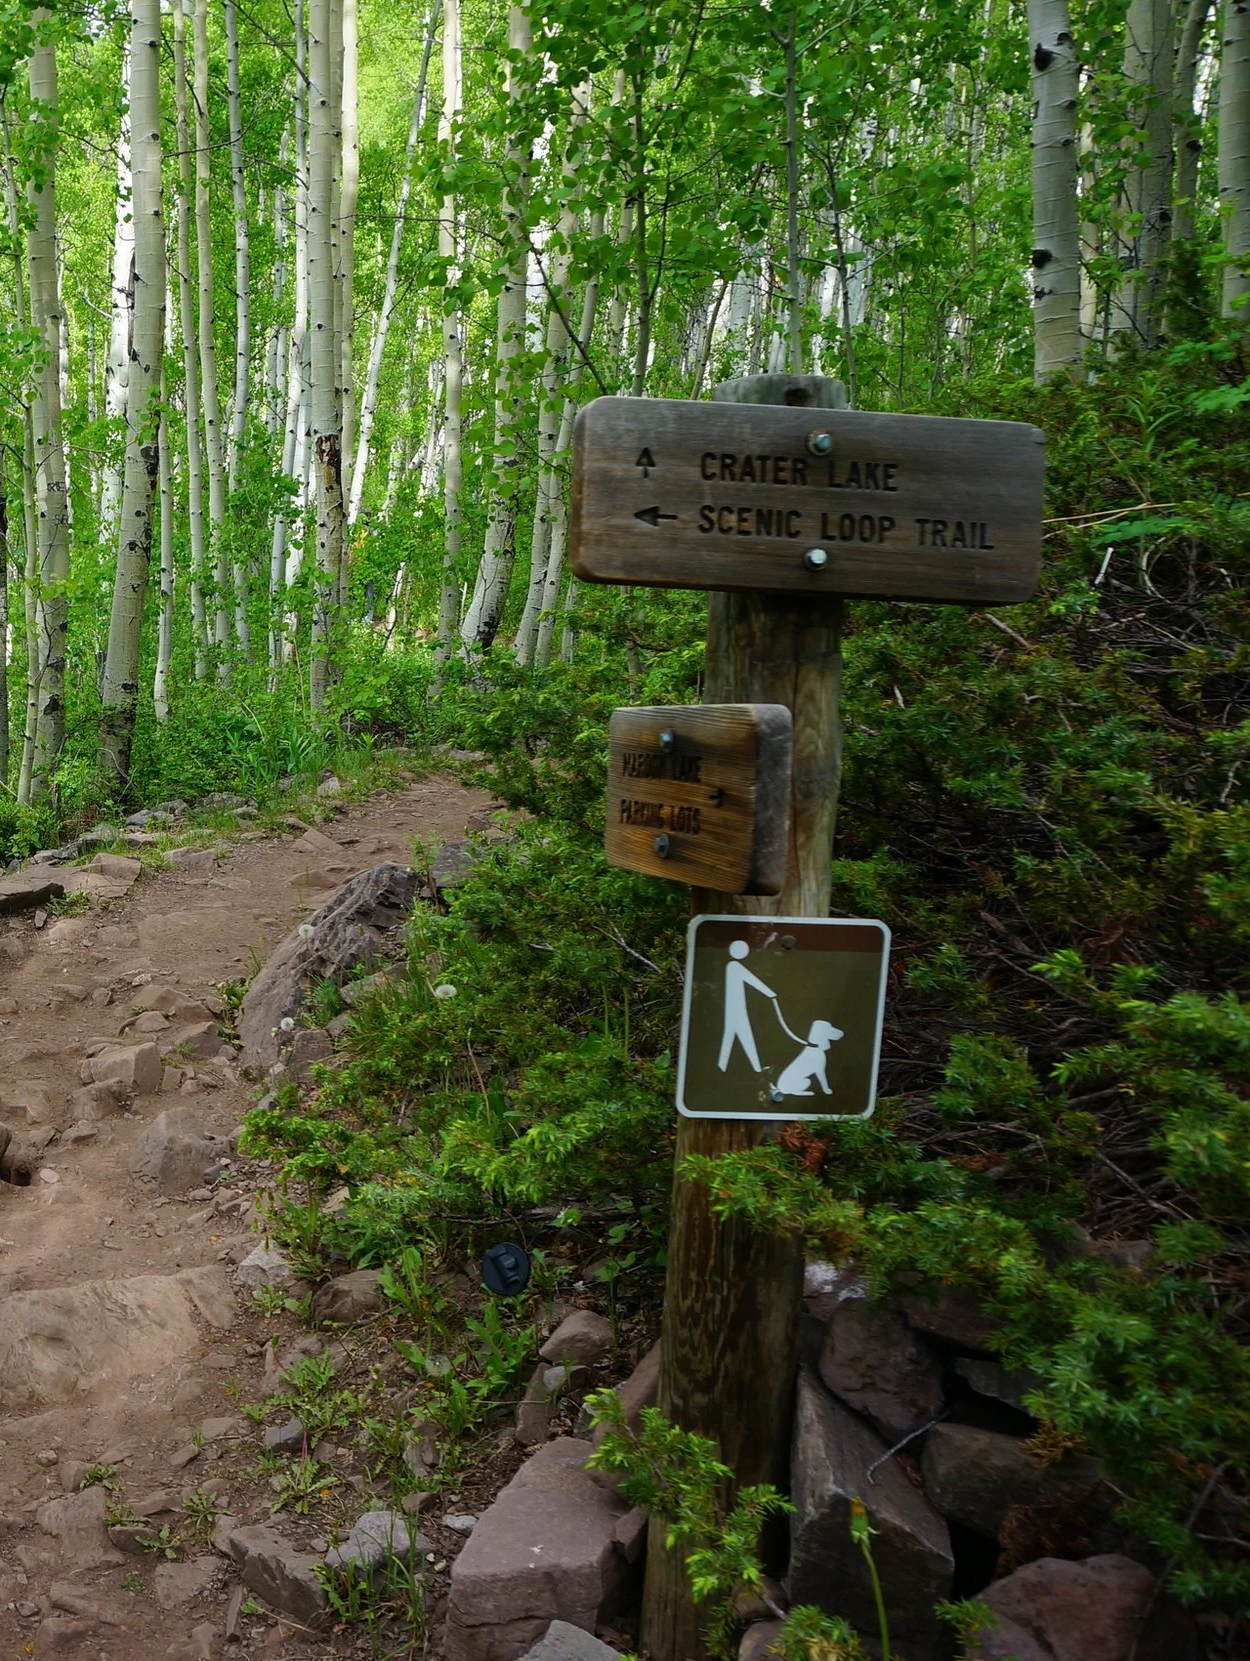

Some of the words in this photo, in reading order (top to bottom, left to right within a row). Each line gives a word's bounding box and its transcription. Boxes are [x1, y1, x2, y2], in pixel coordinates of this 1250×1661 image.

[700, 451, 807, 487] CRATER
[827, 459, 898, 493] LAKE
[698, 504, 802, 540] SCENIC
[820, 512, 897, 544] LOOP
[915, 517, 995, 551] TRAIL
[669, 804, 701, 836] LOTS
